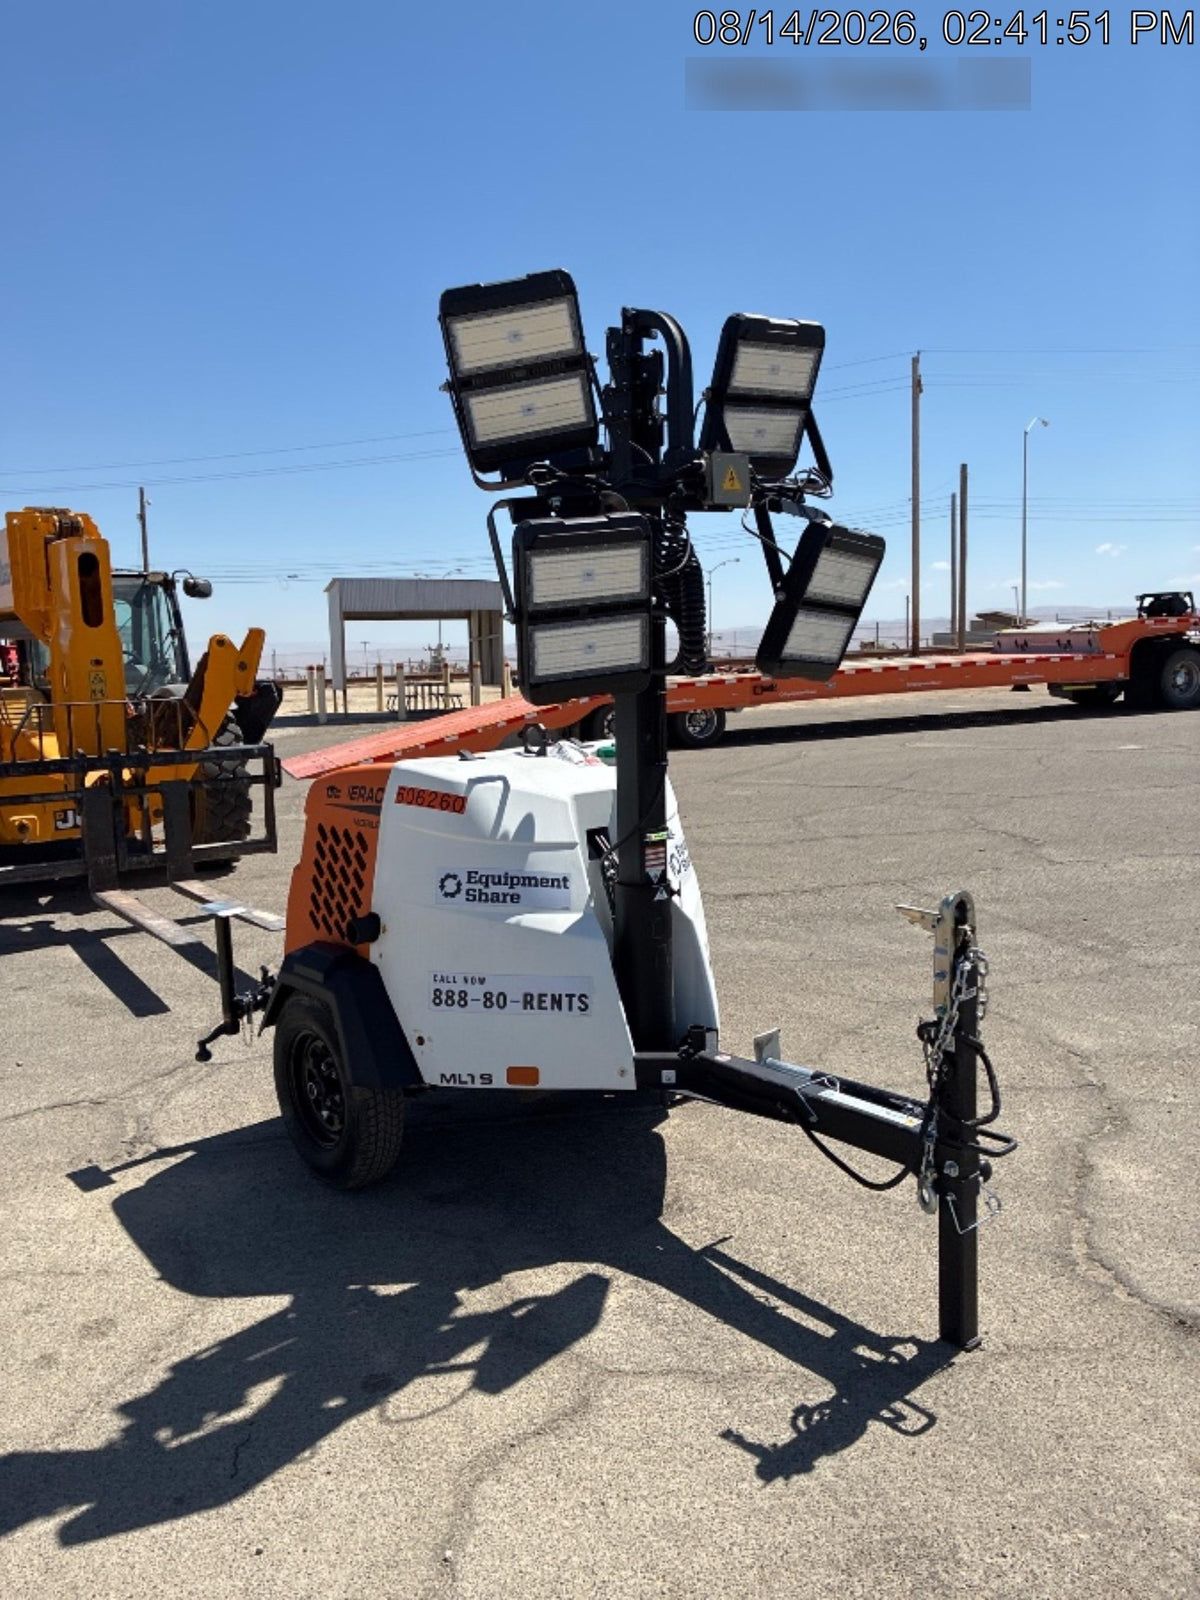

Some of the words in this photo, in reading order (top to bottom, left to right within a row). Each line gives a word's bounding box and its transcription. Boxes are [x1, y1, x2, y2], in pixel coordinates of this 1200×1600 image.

[466, 870, 570, 890] Equipment
[465, 888, 521, 904] Share
[433, 973, 458, 984] CALL
[463, 974, 487, 986] NOW
[432, 988, 590, 1013] 888-80-RENTS
